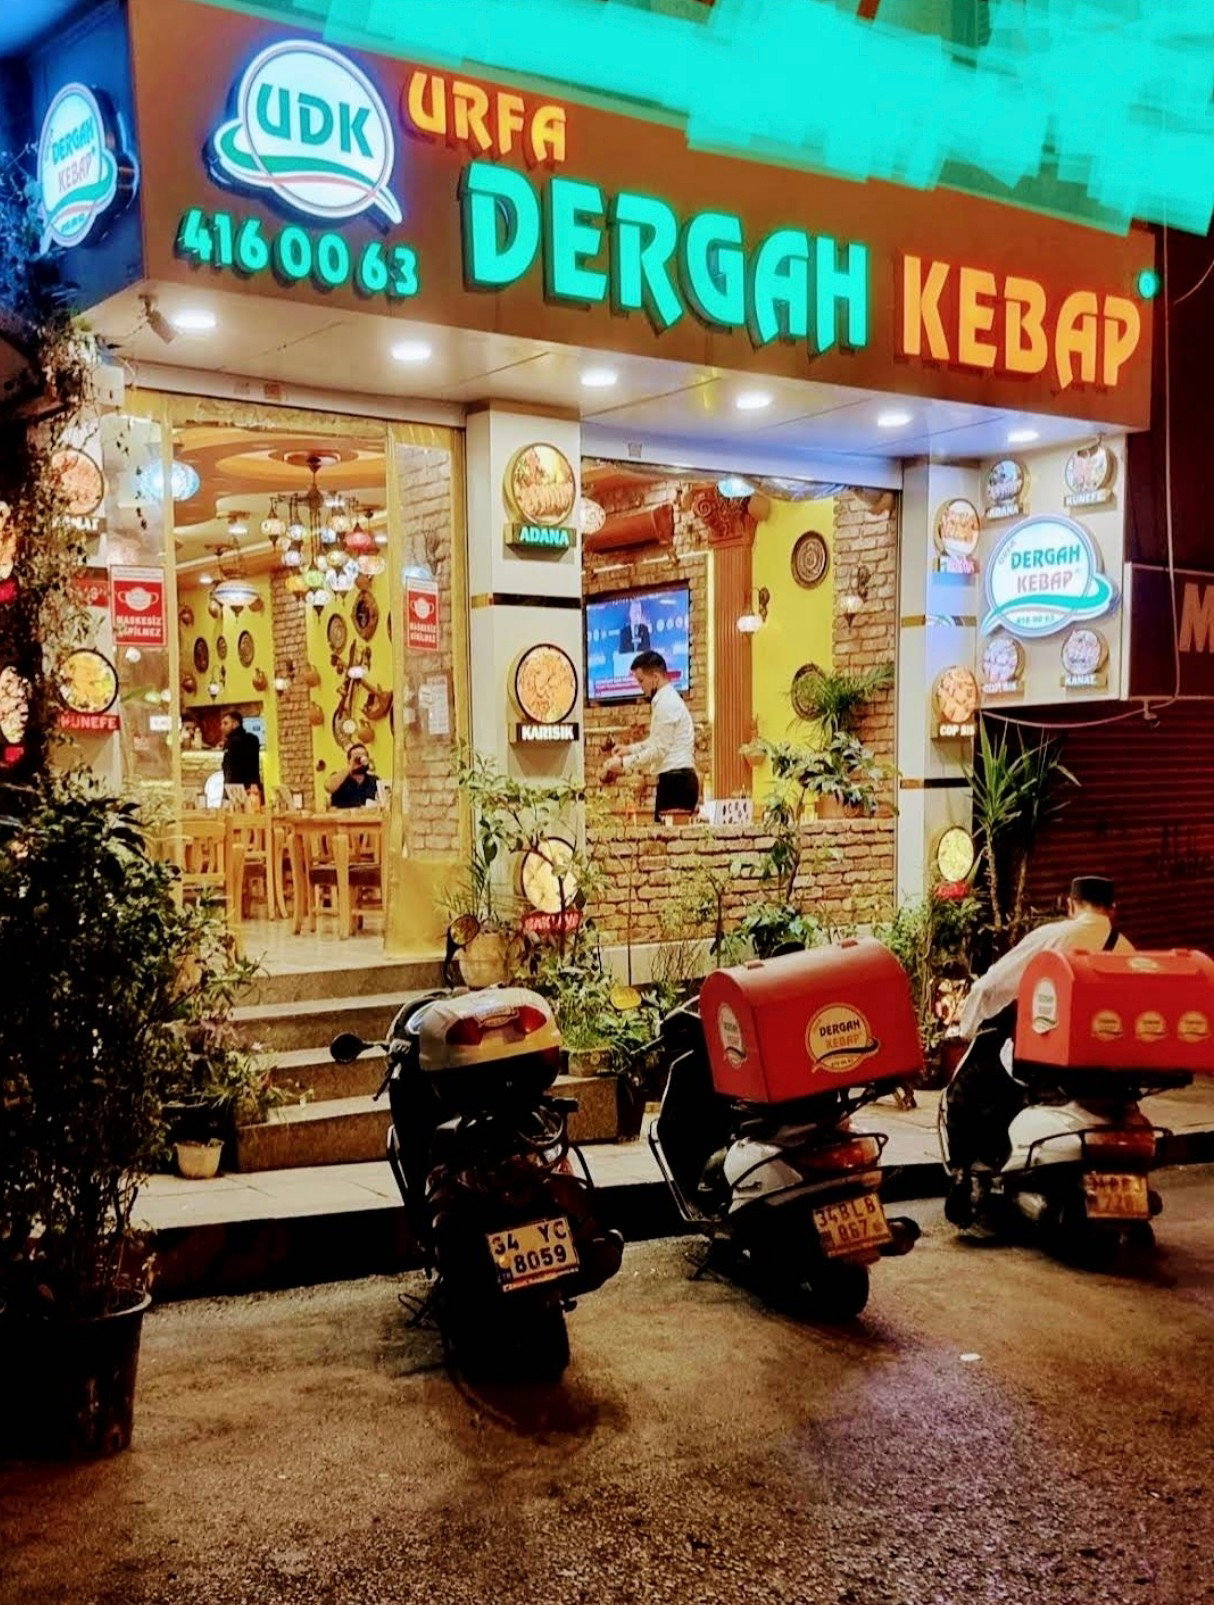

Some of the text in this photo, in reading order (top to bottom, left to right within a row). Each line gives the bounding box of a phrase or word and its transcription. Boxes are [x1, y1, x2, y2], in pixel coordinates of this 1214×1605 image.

[256, 83, 375, 158] UDK
[407, 71, 567, 162] URFA
[58, 152, 92, 193] KEBAP
[465, 162, 868, 353] DERGAH
[902, 253, 1142, 389] KEBAP
[519, 525, 570, 546] ADANA
[1010, 544, 1080, 570] DERGAH
[1017, 570, 1072, 594] KEBAP
[818, 1018, 861, 1038] DERGAH
[492, 1220, 567, 1256] 34 YC
[513, 1243, 567, 1274] 8059
